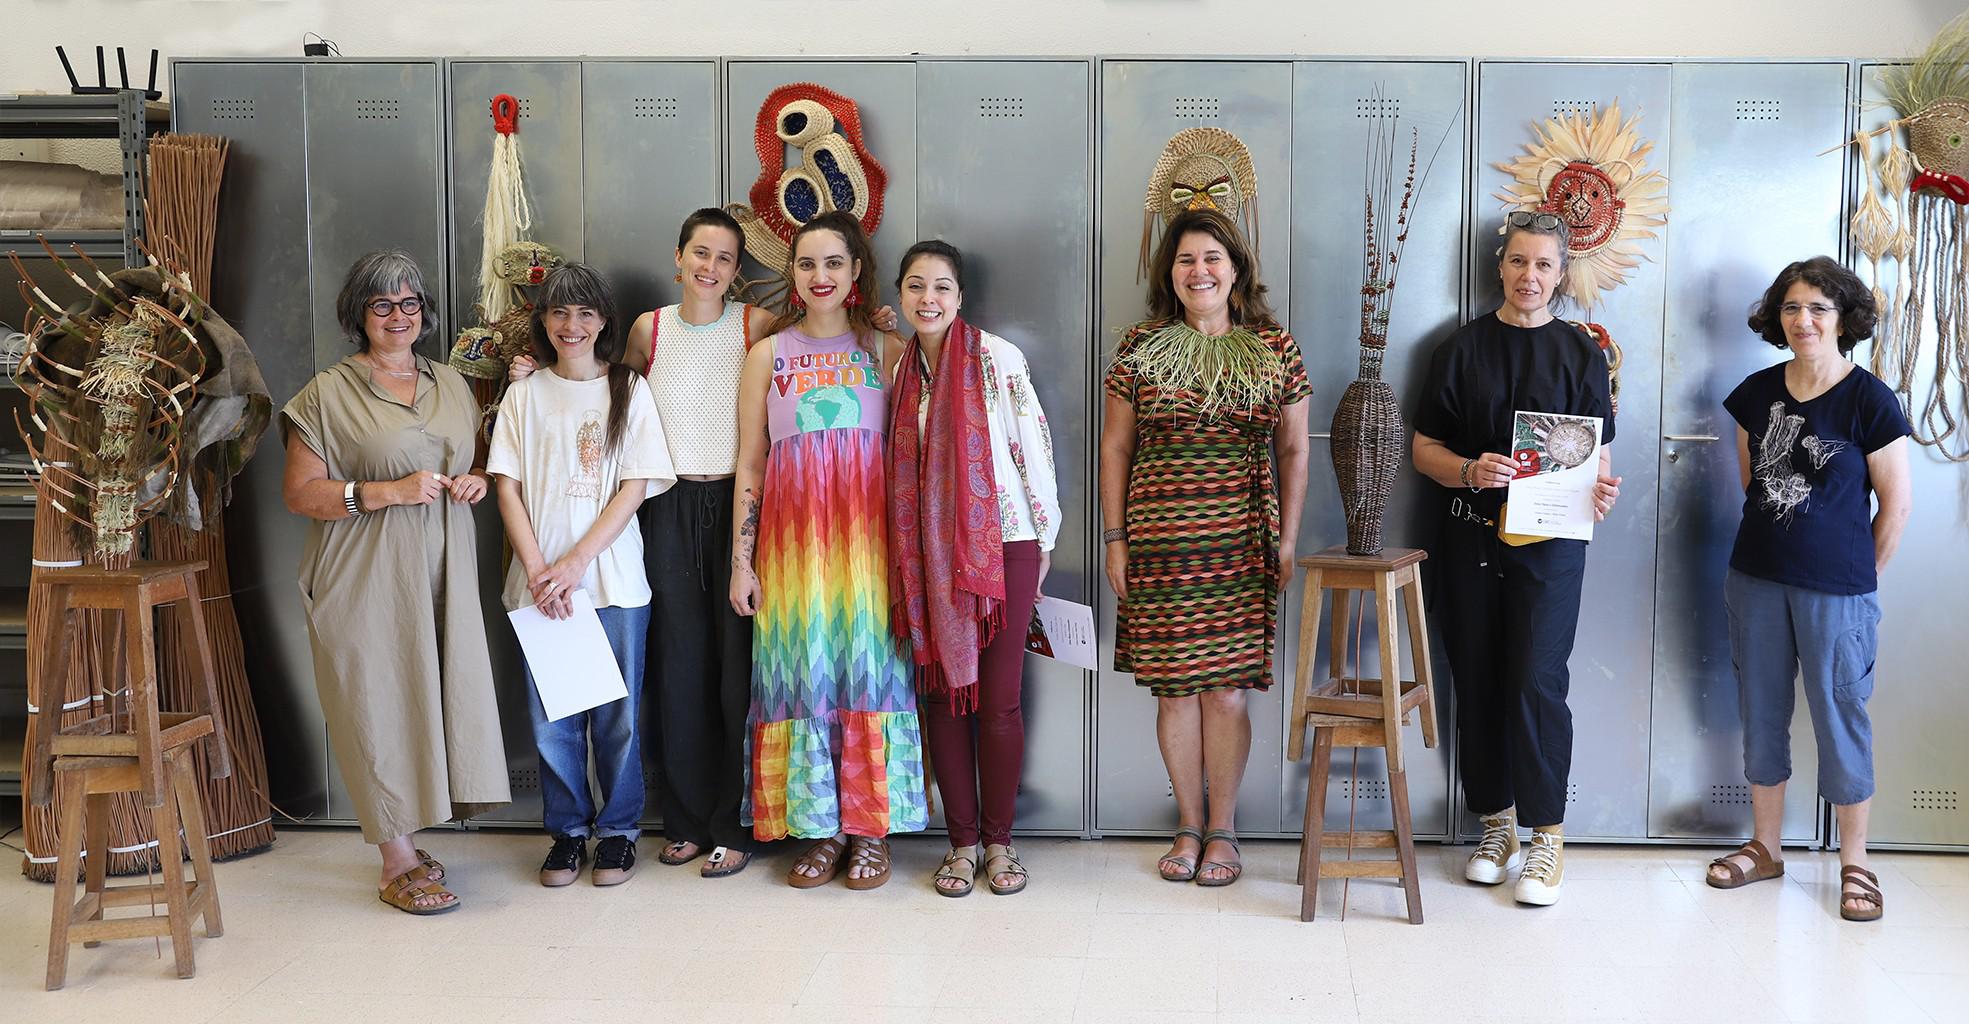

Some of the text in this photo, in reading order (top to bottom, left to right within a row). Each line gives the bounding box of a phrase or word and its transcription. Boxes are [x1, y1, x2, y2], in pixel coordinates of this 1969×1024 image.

[773, 357, 785, 373] O
[788, 351, 863, 371] FUTURO
[773, 367, 884, 399] VERDE
